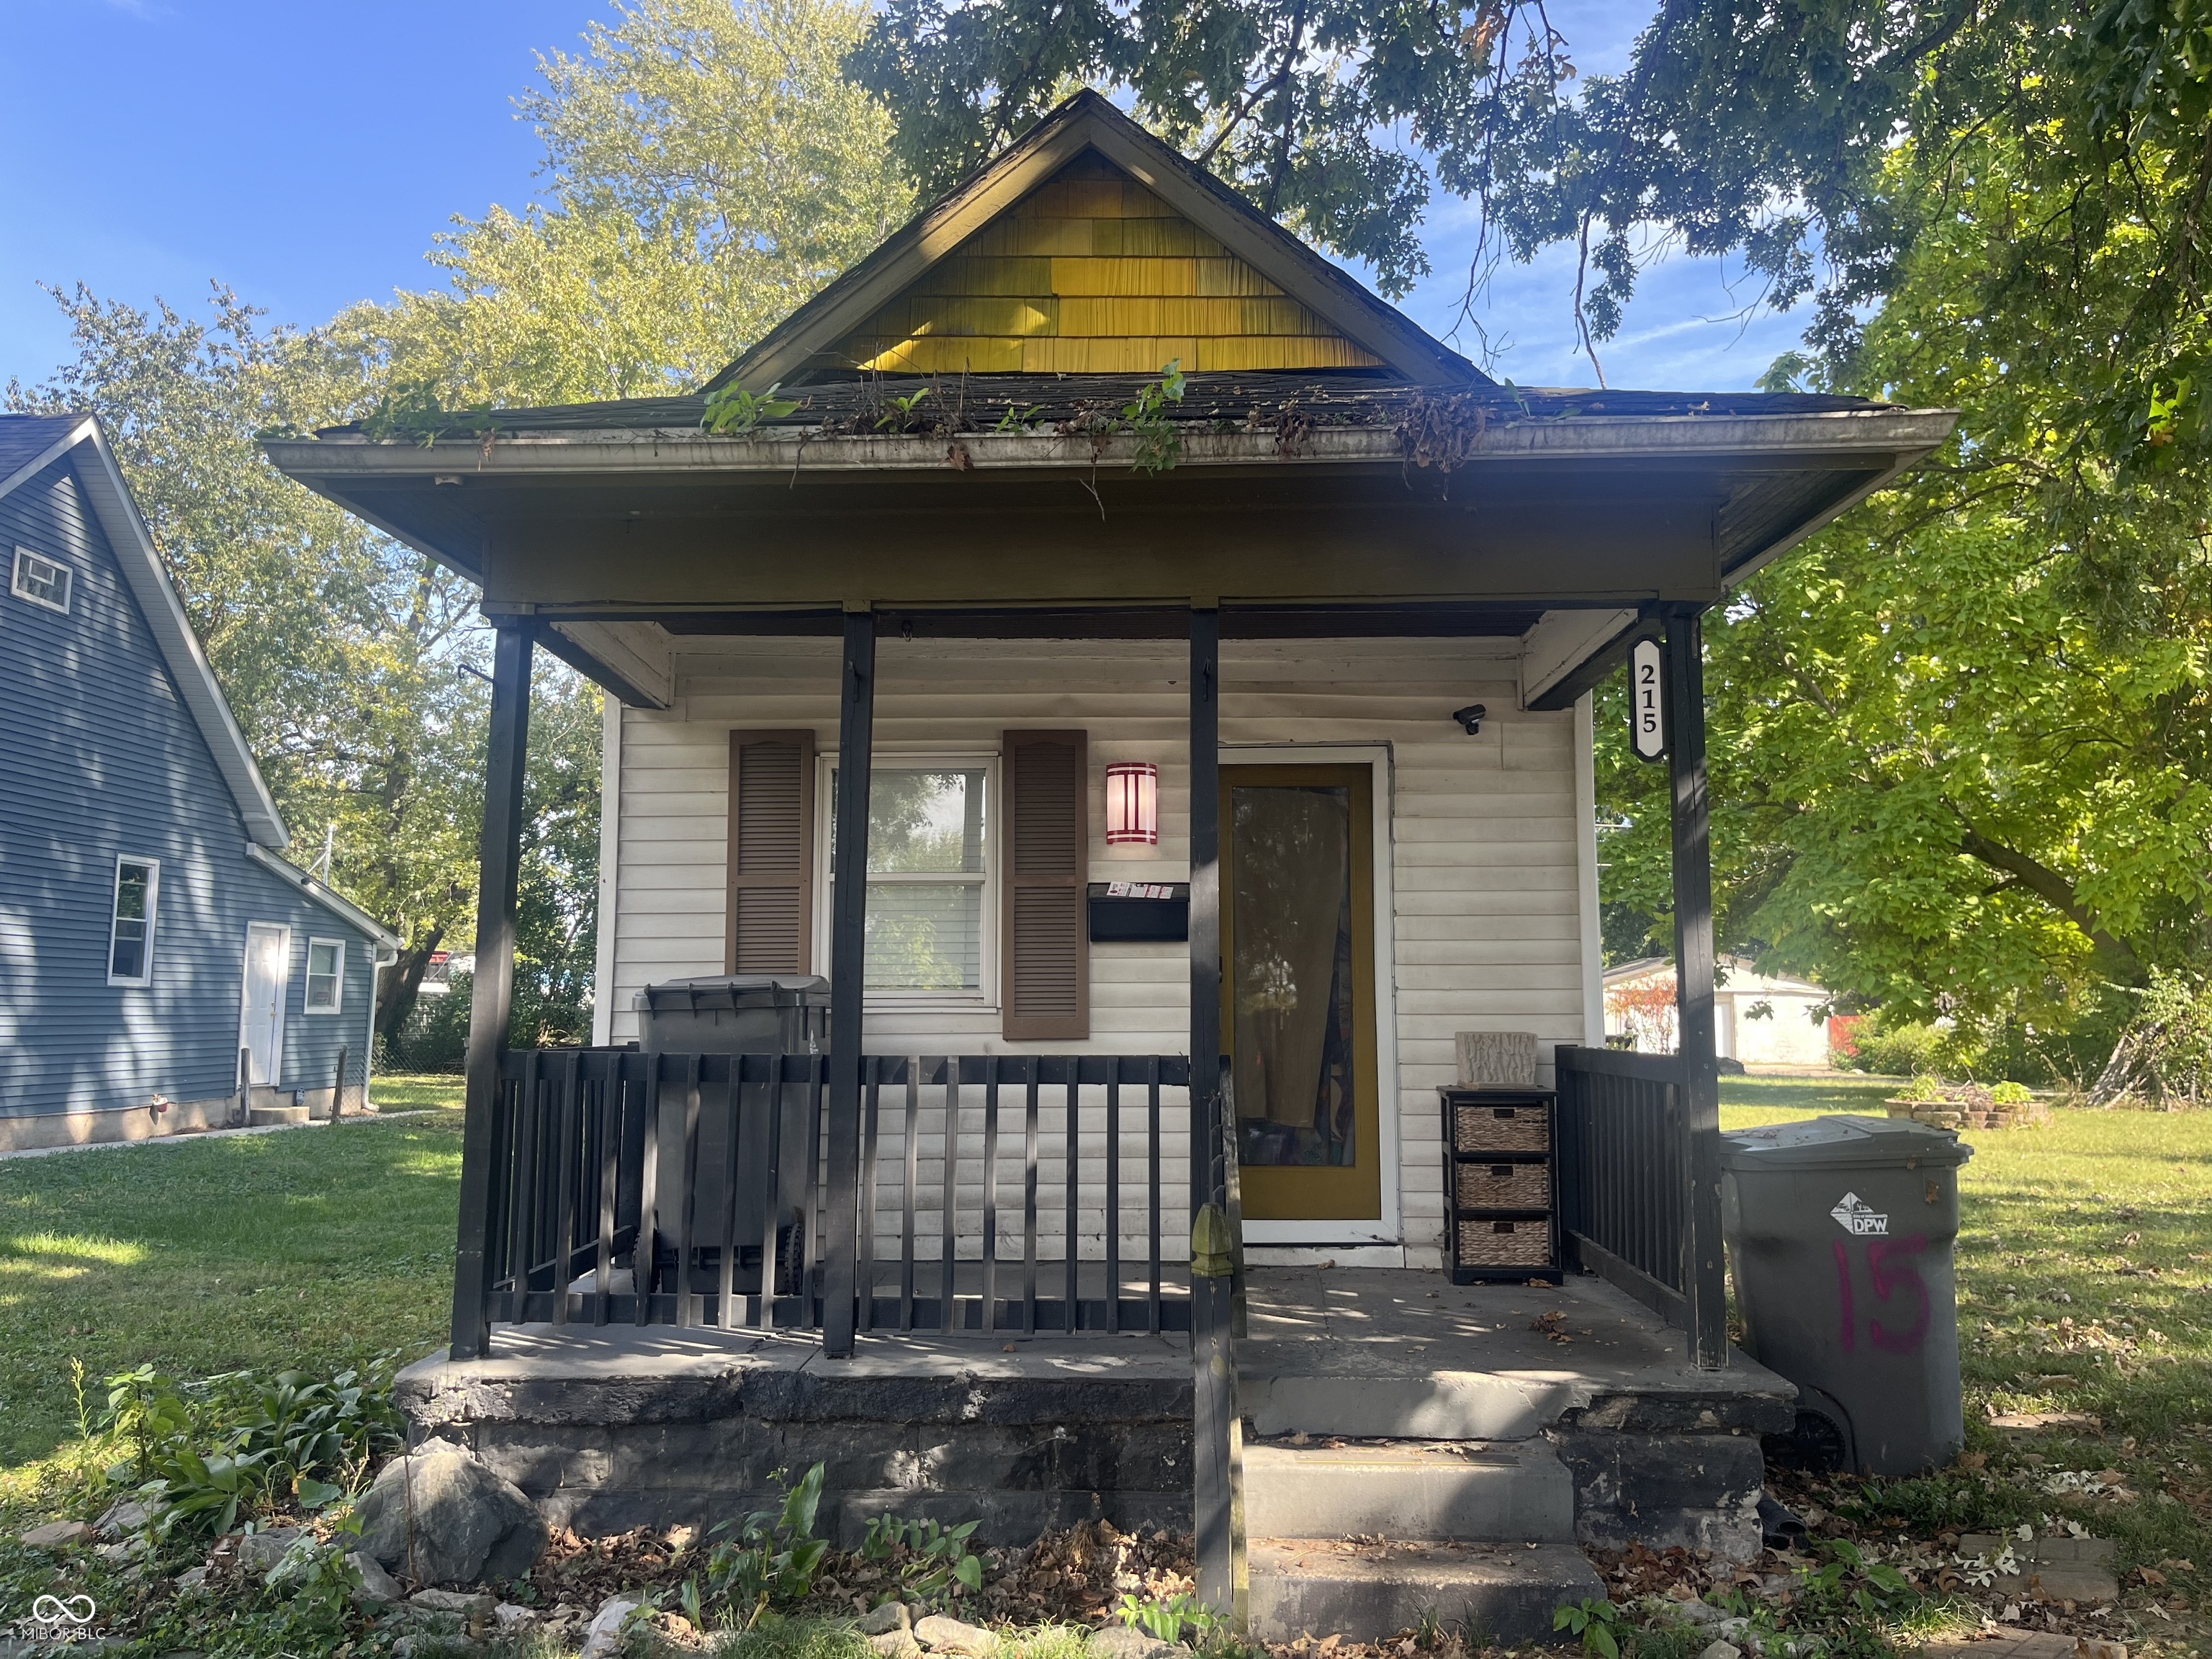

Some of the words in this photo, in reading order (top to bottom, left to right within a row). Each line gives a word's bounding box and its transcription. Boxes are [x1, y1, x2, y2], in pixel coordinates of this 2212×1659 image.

[1641, 665, 1656, 733] 215
[1853, 1218, 1887, 1232] DPW
[1833, 1231, 1931, 1355] 15
